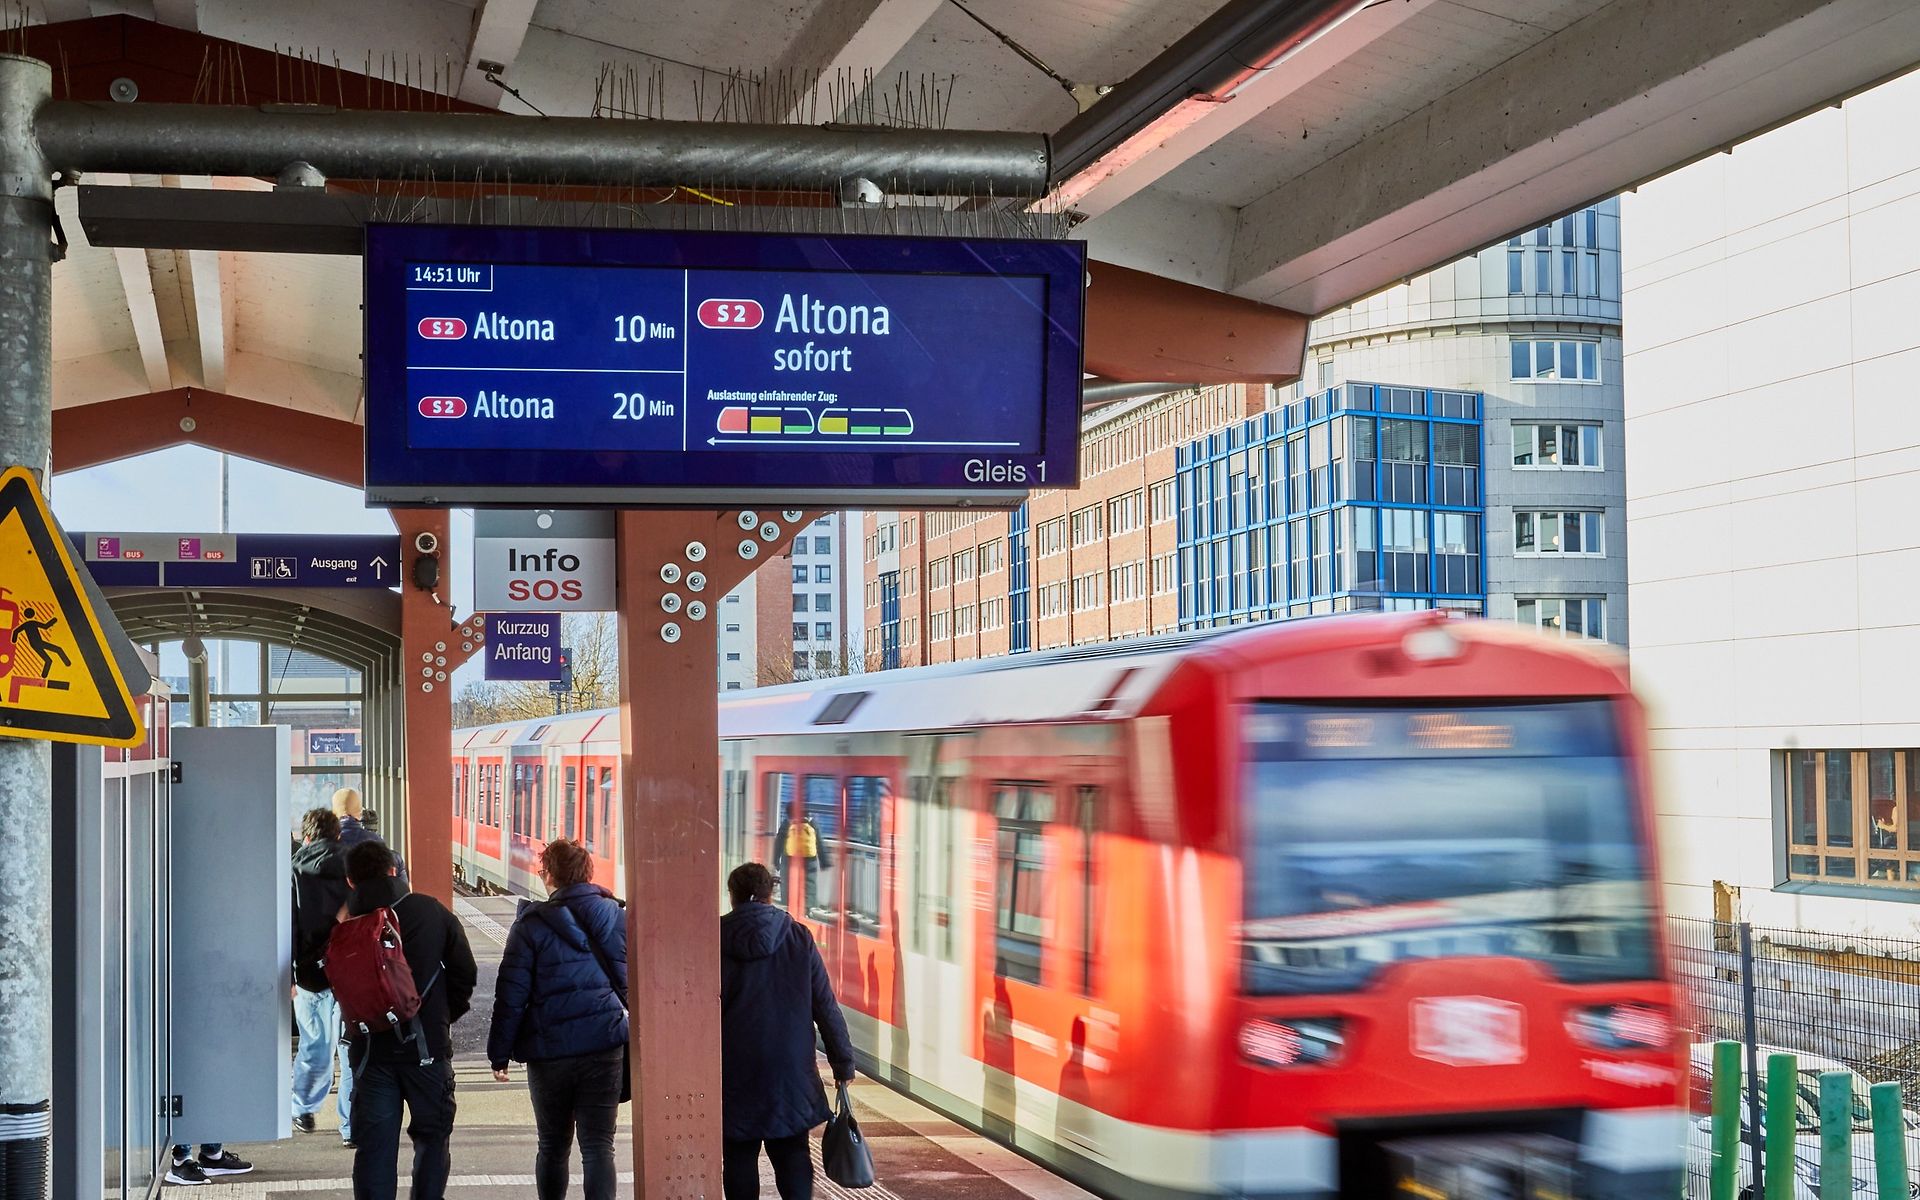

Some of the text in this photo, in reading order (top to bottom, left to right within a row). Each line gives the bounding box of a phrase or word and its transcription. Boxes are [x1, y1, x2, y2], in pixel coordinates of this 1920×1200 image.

[415, 266, 481, 283] 14:51 Uhr
[774, 293, 890, 335] Altona
[473, 311, 555, 341] Altona
[614, 315, 646, 343] 10
[649, 322, 675, 339] Min
[773, 341, 852, 372] sofort
[473, 390, 555, 419] Altona
[612, 392, 646, 420] 20
[649, 400, 675, 417] Min
[707, 389, 838, 404] Auslastung einfahrender Zug:
[963, 458, 1047, 482] Gleis 1
[310, 557, 358, 570] Ausgang
[508, 548, 580, 572] Info
[508, 579, 583, 601] SOS
[497, 620, 550, 638] Kurzzug
[495, 642, 551, 664] Anfang
